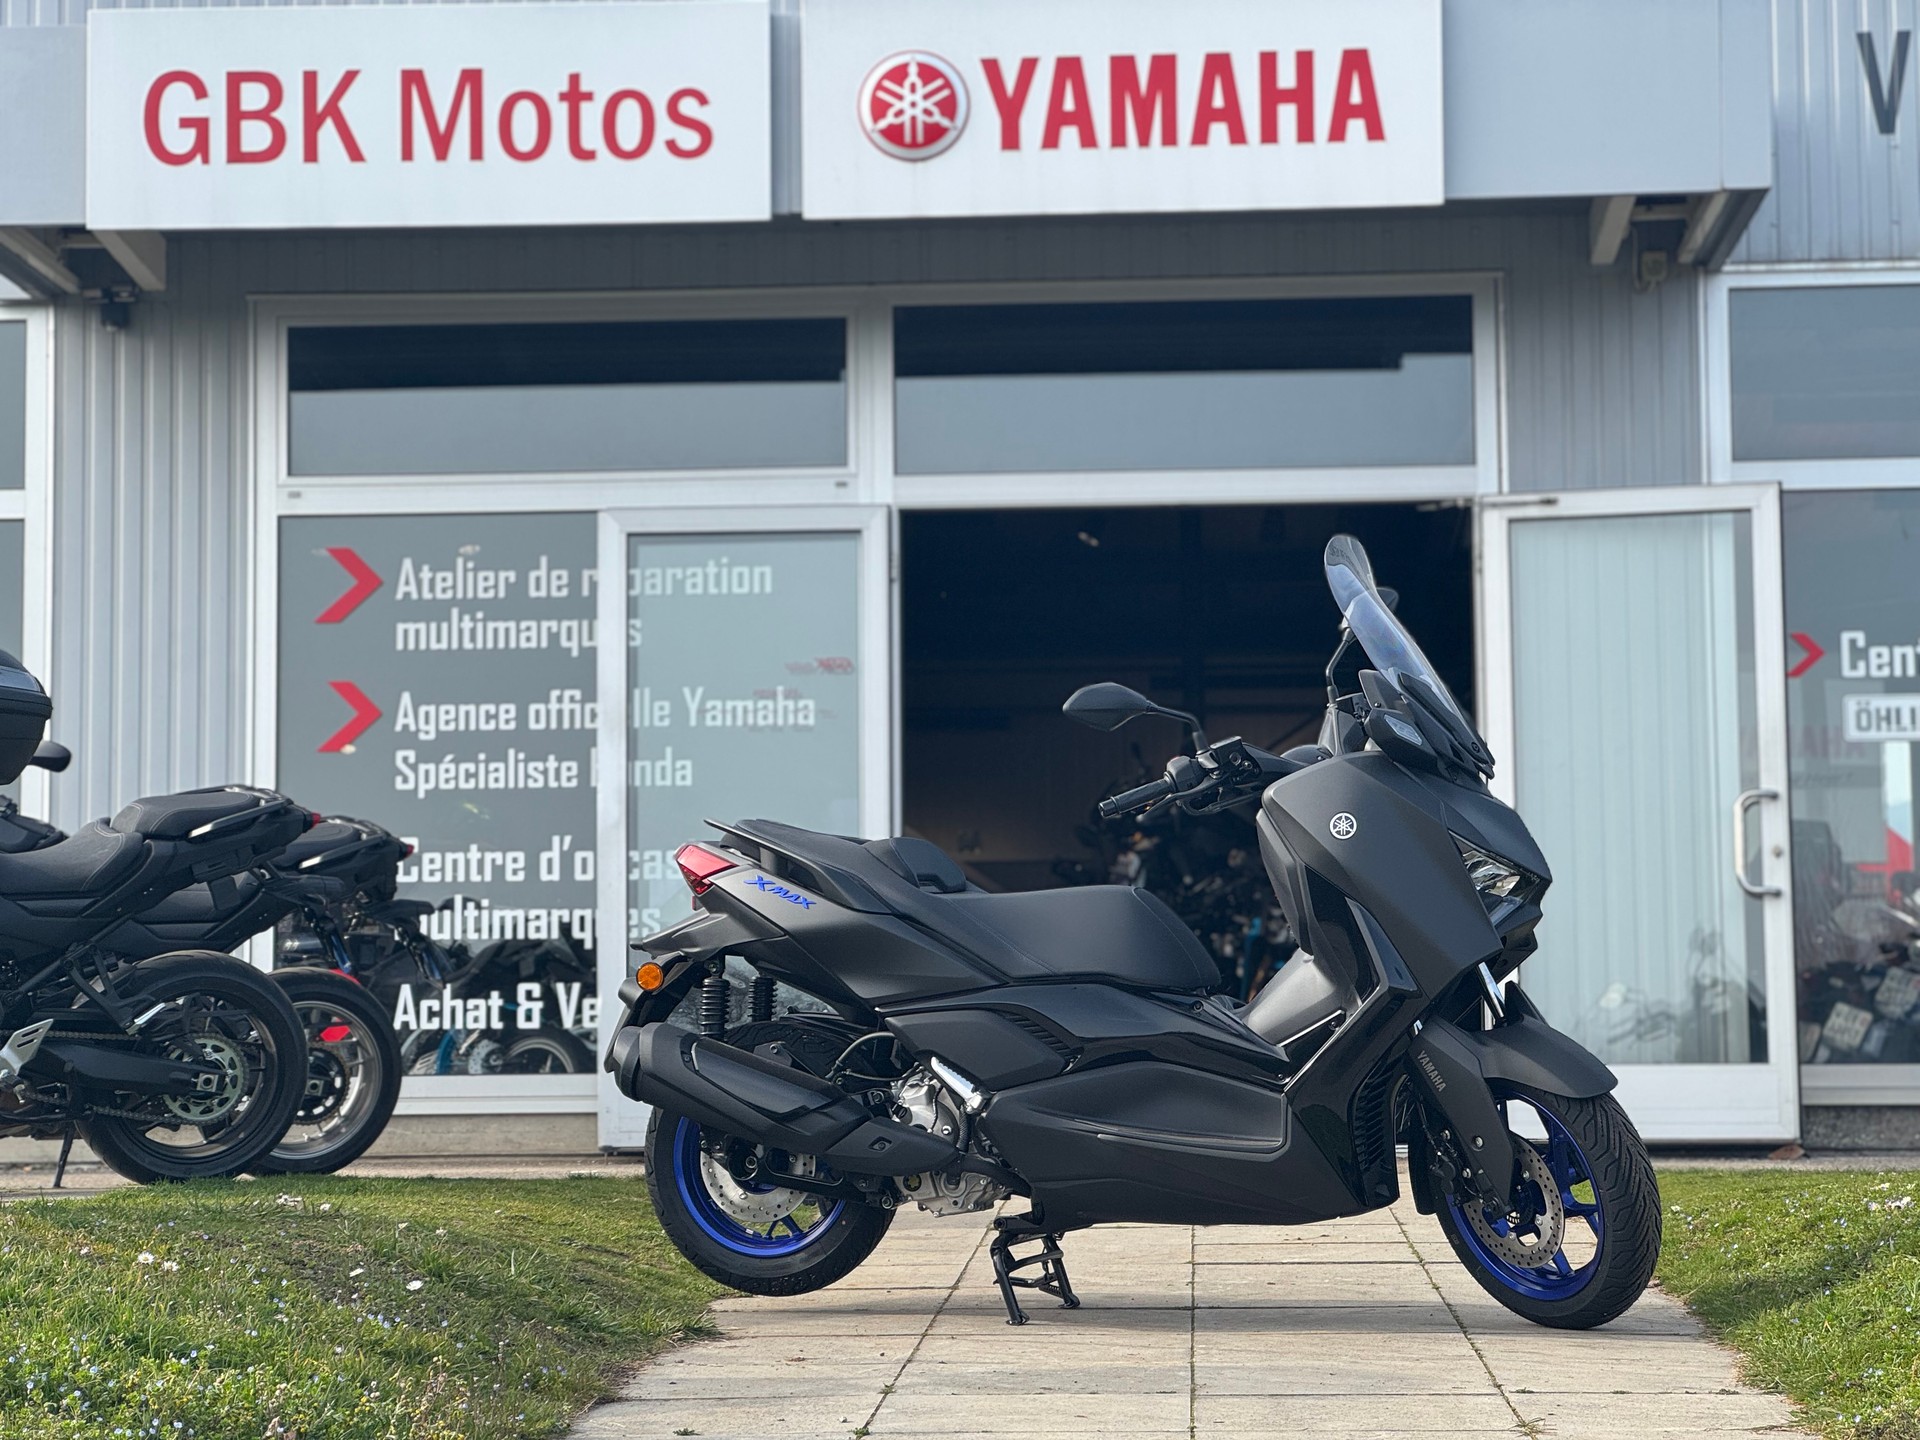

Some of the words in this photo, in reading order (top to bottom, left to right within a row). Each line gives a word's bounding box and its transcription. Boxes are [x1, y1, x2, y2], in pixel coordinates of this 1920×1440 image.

[143, 69, 365, 166] GBK
[400, 68, 714, 162] Motos
[980, 48, 1386, 151] YAMAHA
[395, 557, 516, 601] Atelier
[528, 555, 569, 598] de
[581, 557, 773, 598] rparation
[395, 607, 642, 657] multimarqus
[395, 691, 516, 740] Agence
[528, 687, 671, 731] officlle
[682, 685, 815, 727] Yamaha
[395, 748, 579, 798] Spécialiste
[590, 746, 692, 788] nda
[394, 893, 661, 950] ultimarqes
[393, 983, 504, 1030] Achat
[516, 982, 544, 1030] &
[1417, 1050, 1447, 1092] YAMAHA
